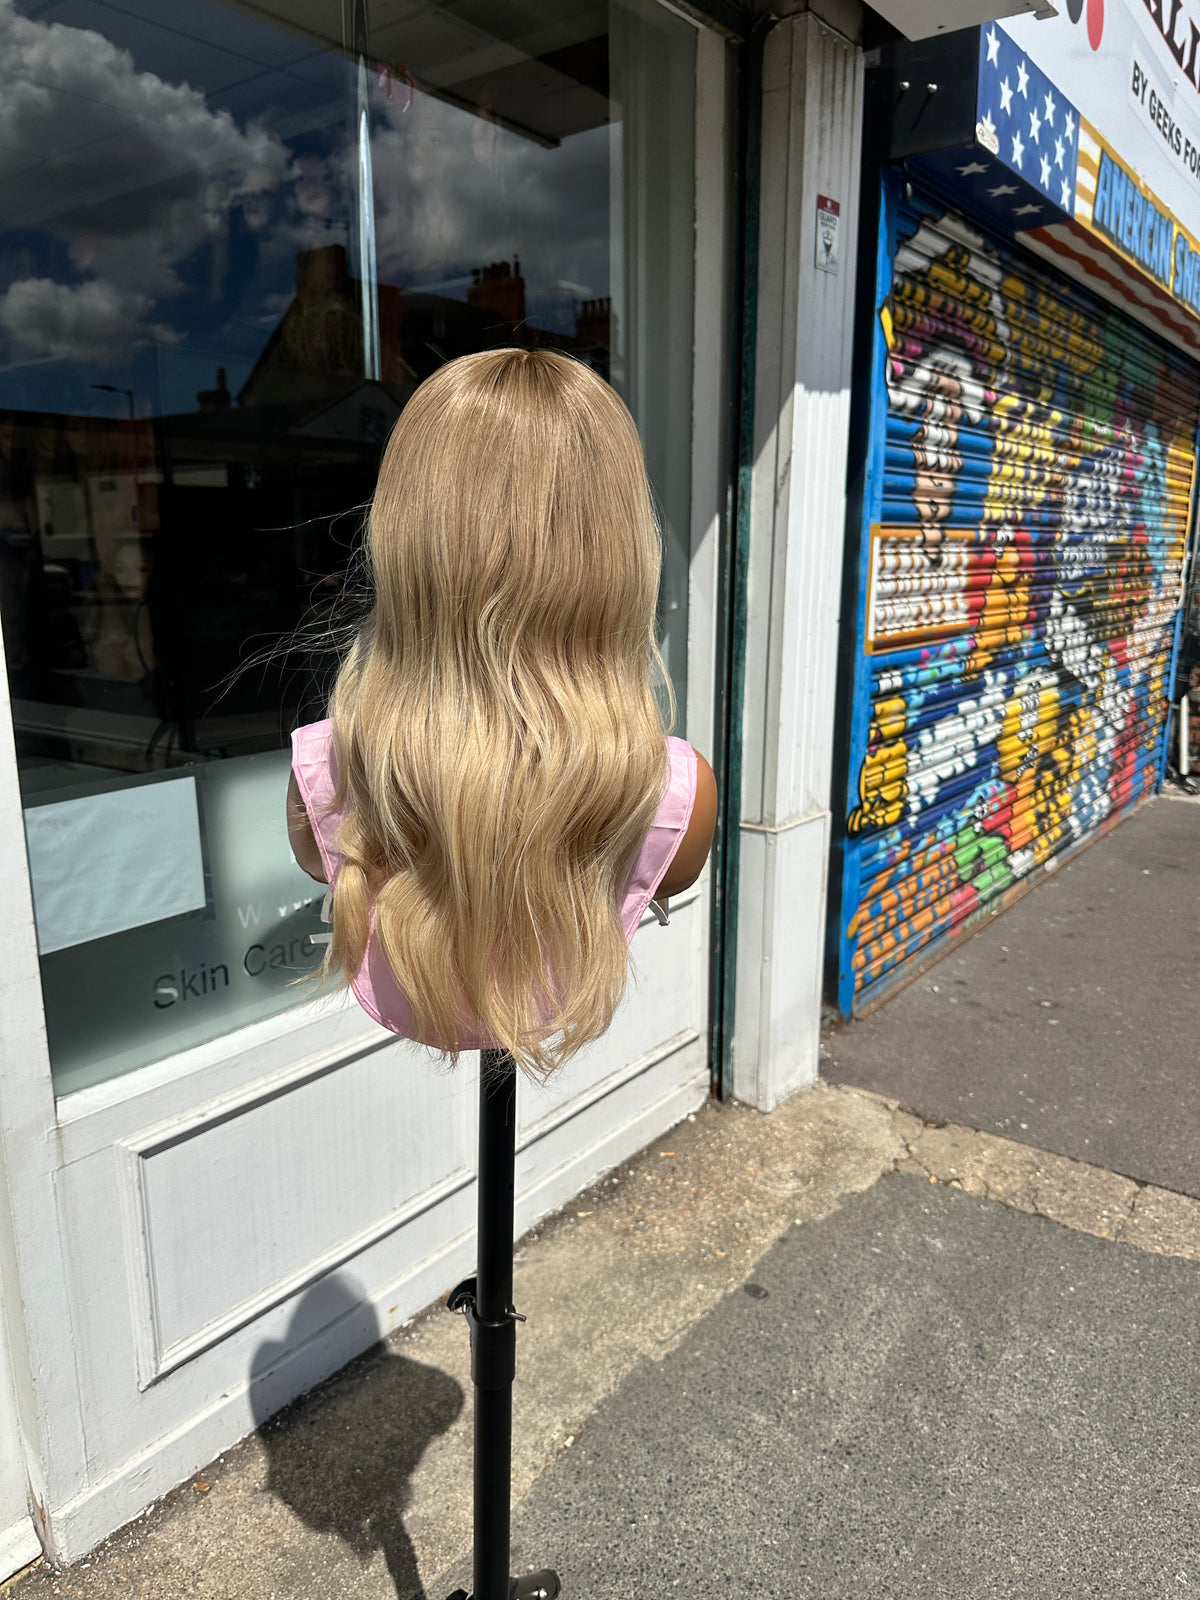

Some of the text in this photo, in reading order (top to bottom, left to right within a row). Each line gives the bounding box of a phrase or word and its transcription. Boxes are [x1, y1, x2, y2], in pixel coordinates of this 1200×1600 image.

[1131, 60, 1148, 105] BY
[1149, 88, 1182, 156] GEEKS
[1092, 147, 1174, 289] AMERICAN
[152, 933, 318, 1010] Skin Care
